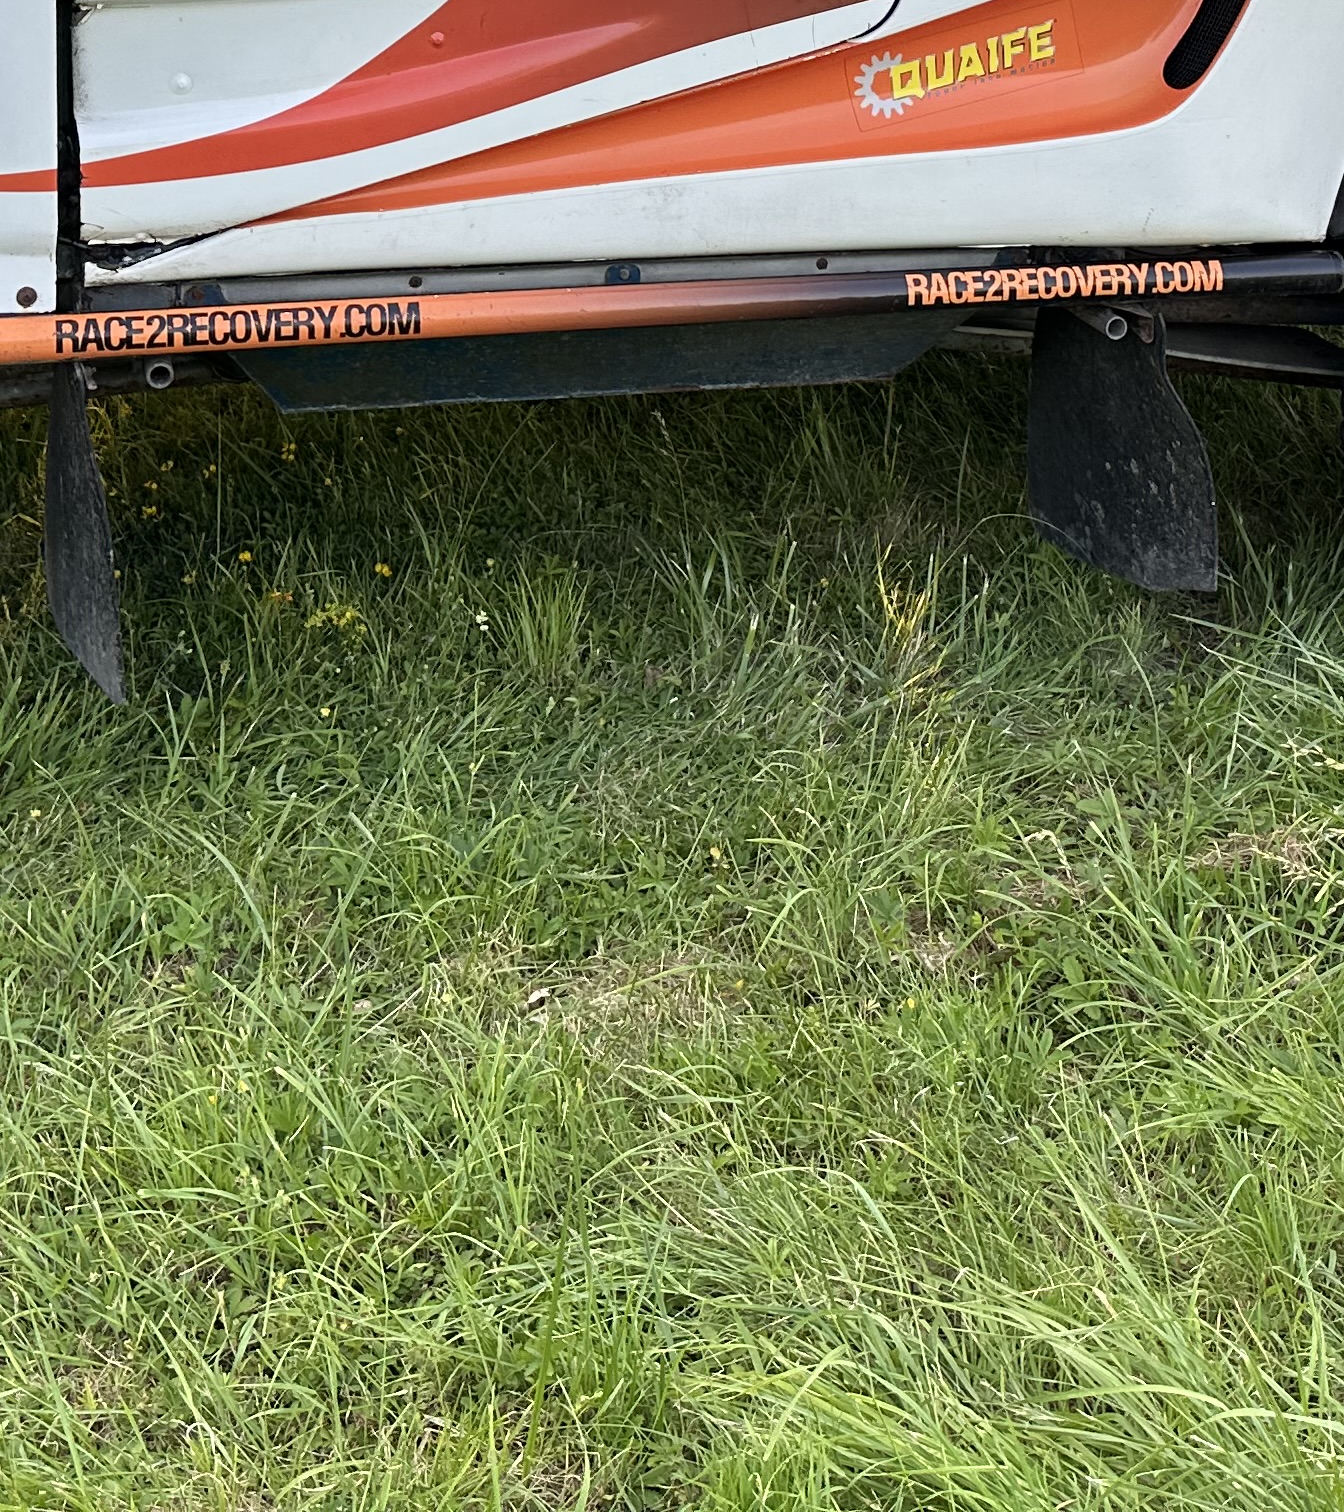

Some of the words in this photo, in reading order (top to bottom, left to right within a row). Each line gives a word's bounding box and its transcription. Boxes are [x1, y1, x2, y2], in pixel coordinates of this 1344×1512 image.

[889, 18, 1056, 100] QUAIFE
[905, 259, 1224, 306] RACE2RECOVERY.COM
[55, 301, 421, 355] RACE2RECOVERY.COM
